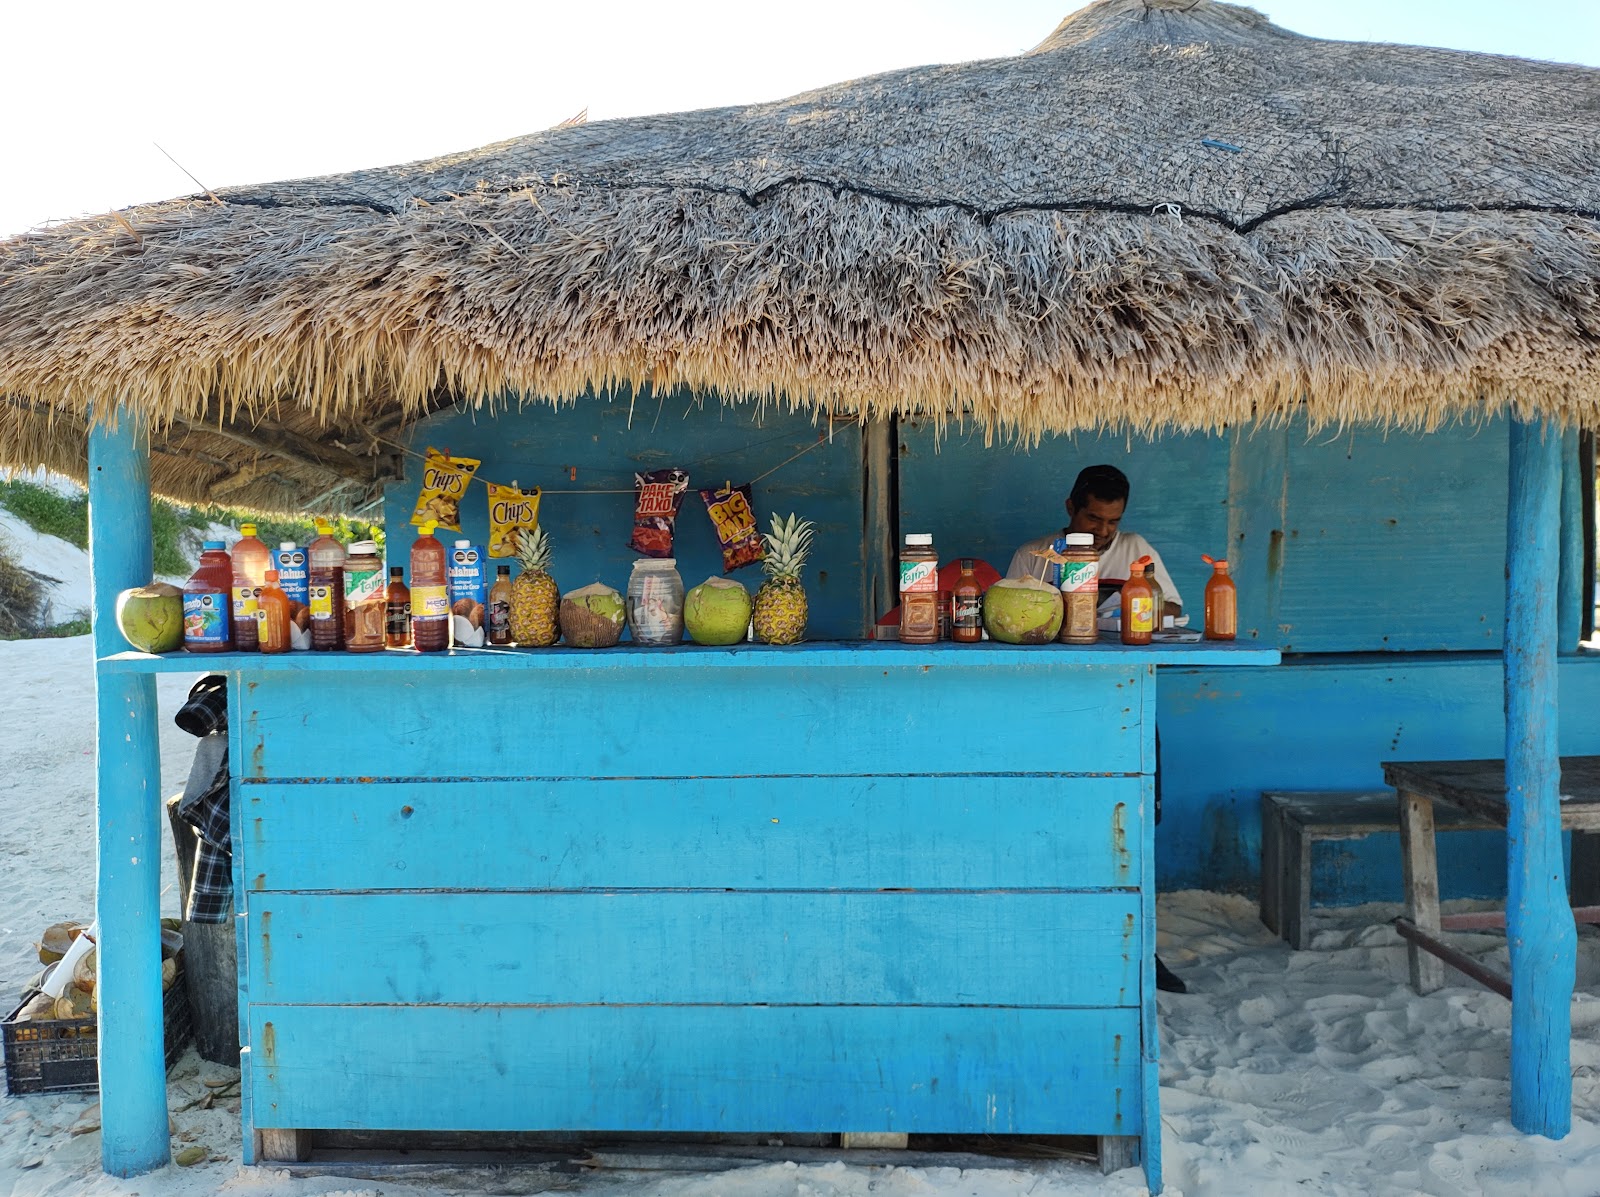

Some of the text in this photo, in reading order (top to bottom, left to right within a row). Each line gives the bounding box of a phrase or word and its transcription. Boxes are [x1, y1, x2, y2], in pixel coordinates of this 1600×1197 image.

[641, 483, 676, 499] PAKE
[639, 498, 673, 512] TAXO
[708, 491, 746, 525] BIG
[719, 508, 756, 543] MIX
